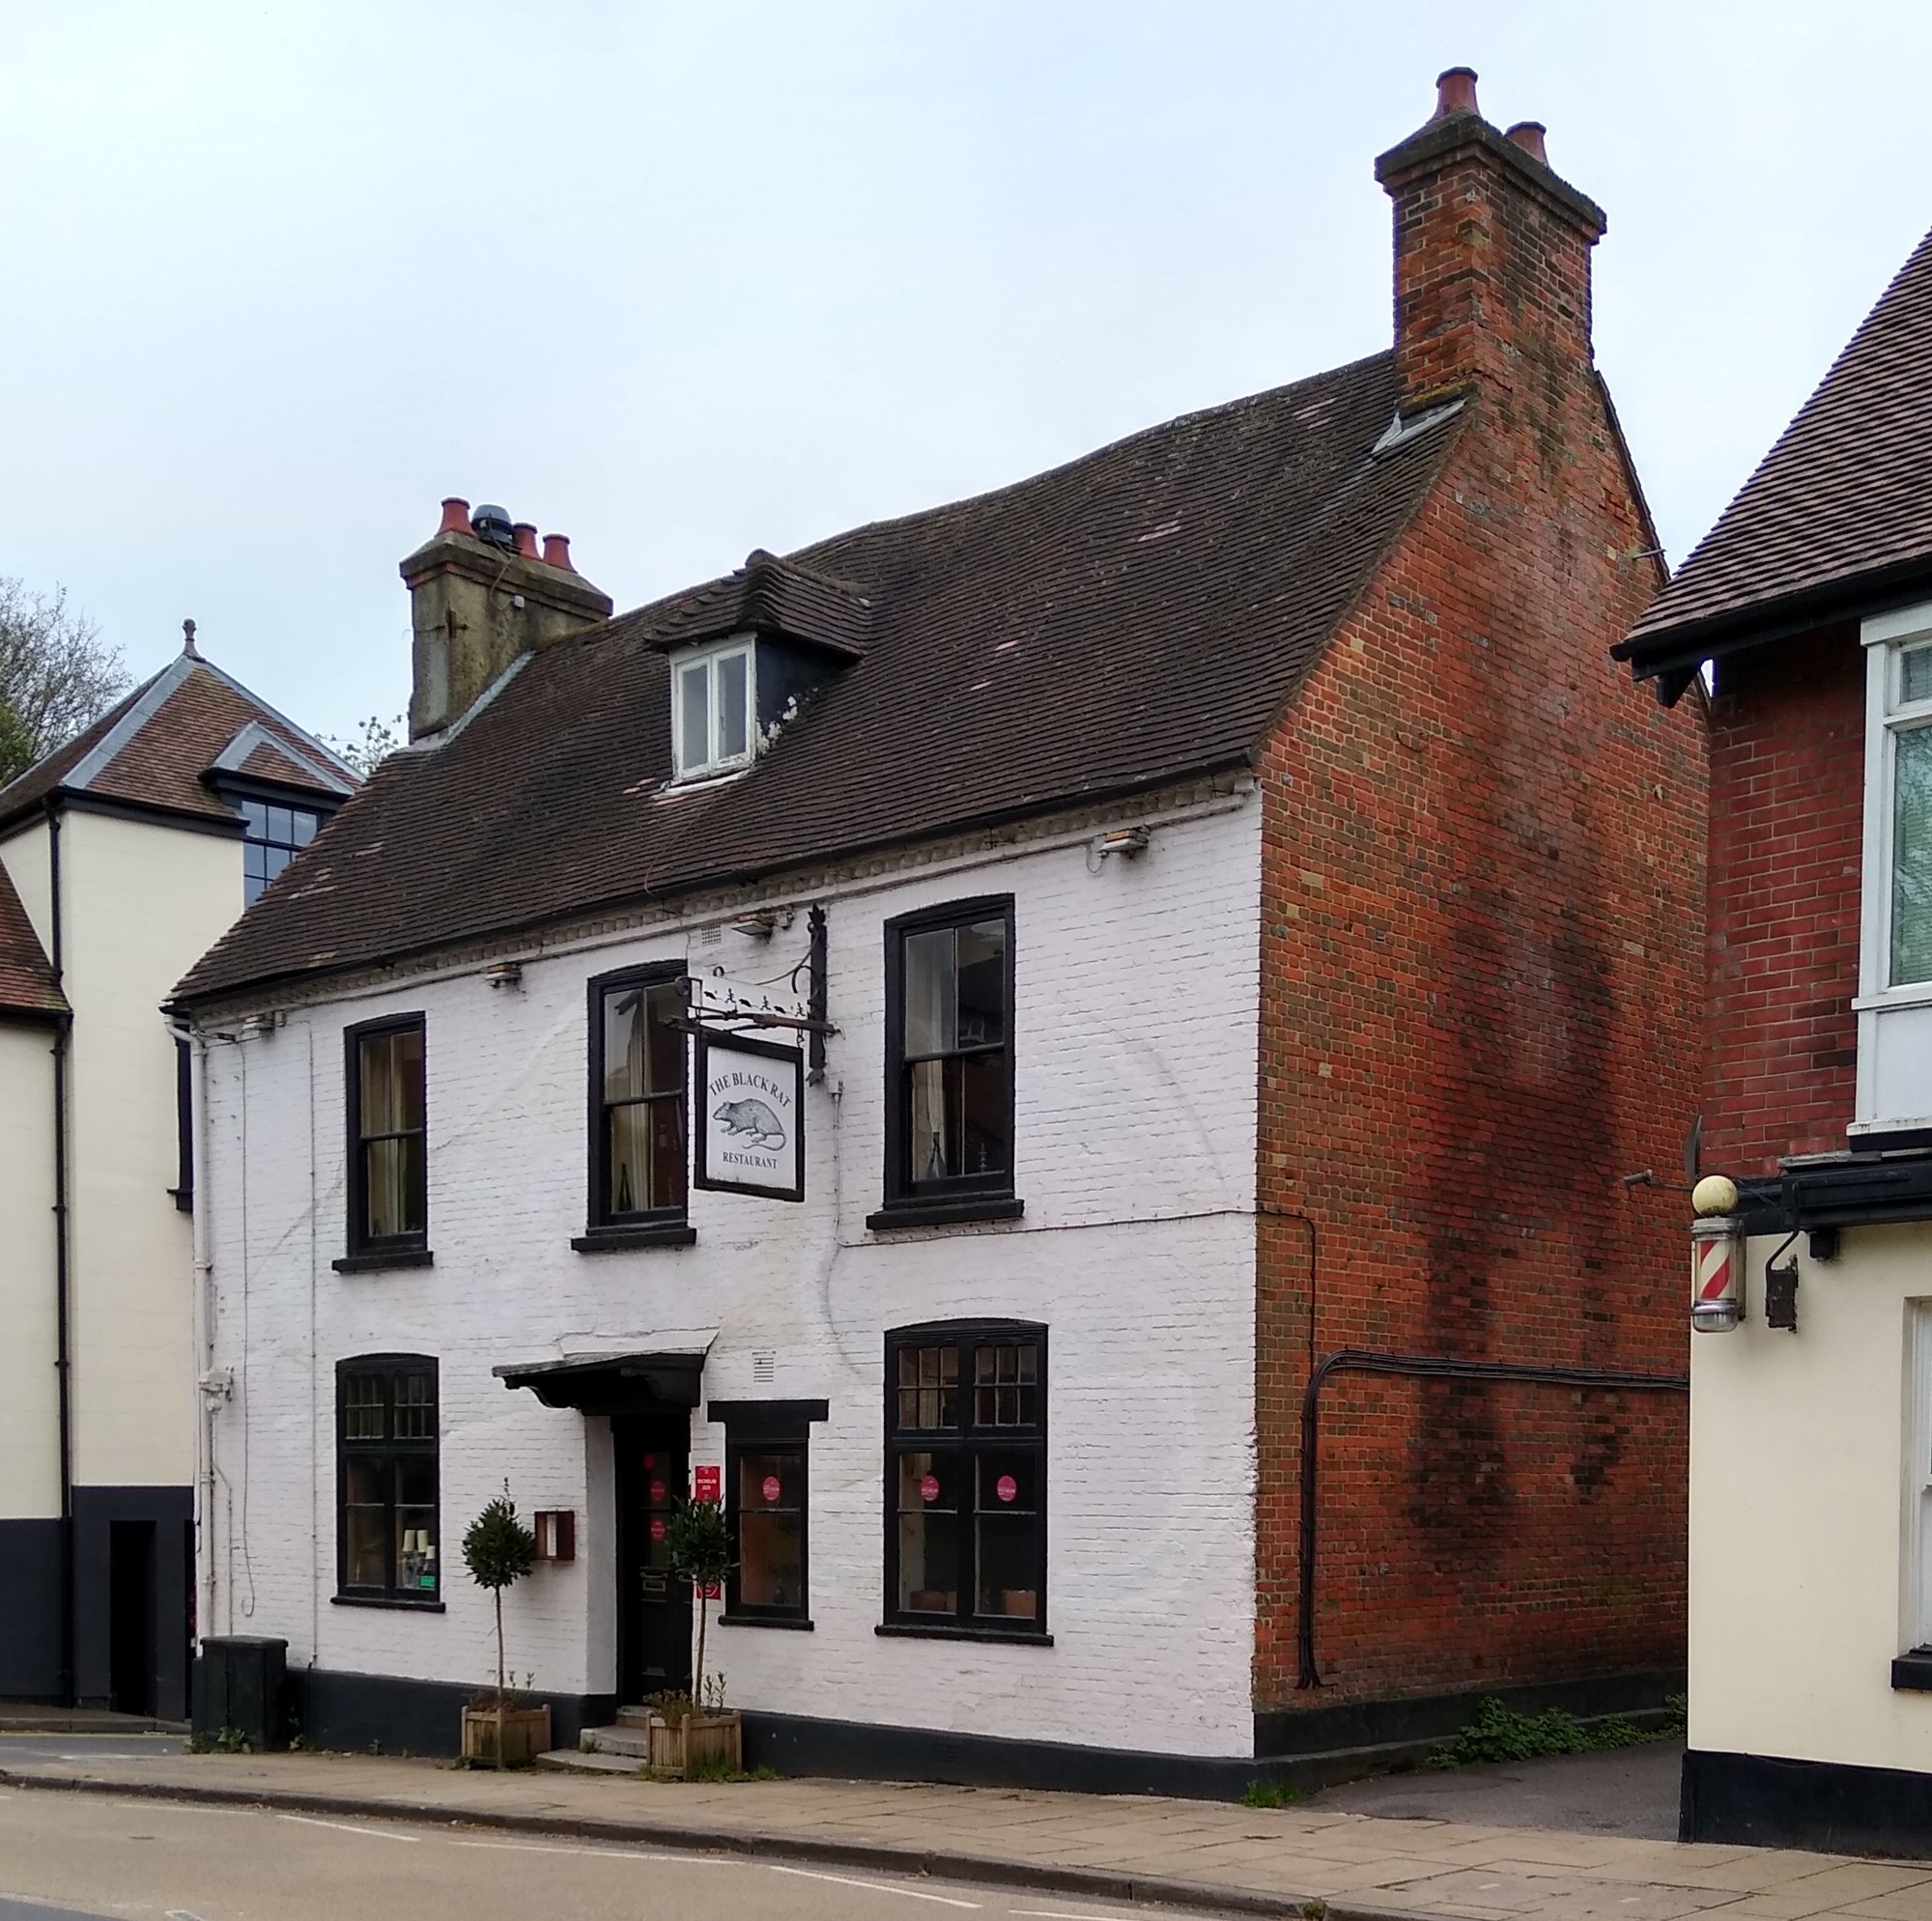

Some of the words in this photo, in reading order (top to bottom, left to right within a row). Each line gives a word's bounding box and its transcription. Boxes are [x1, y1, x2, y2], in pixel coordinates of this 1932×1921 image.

[709, 1074, 731, 1096] THE
[731, 1072, 769, 1091] BLACK
[770, 1083, 791, 1108] RAT
[723, 1151, 778, 1169] RESTAURANT
